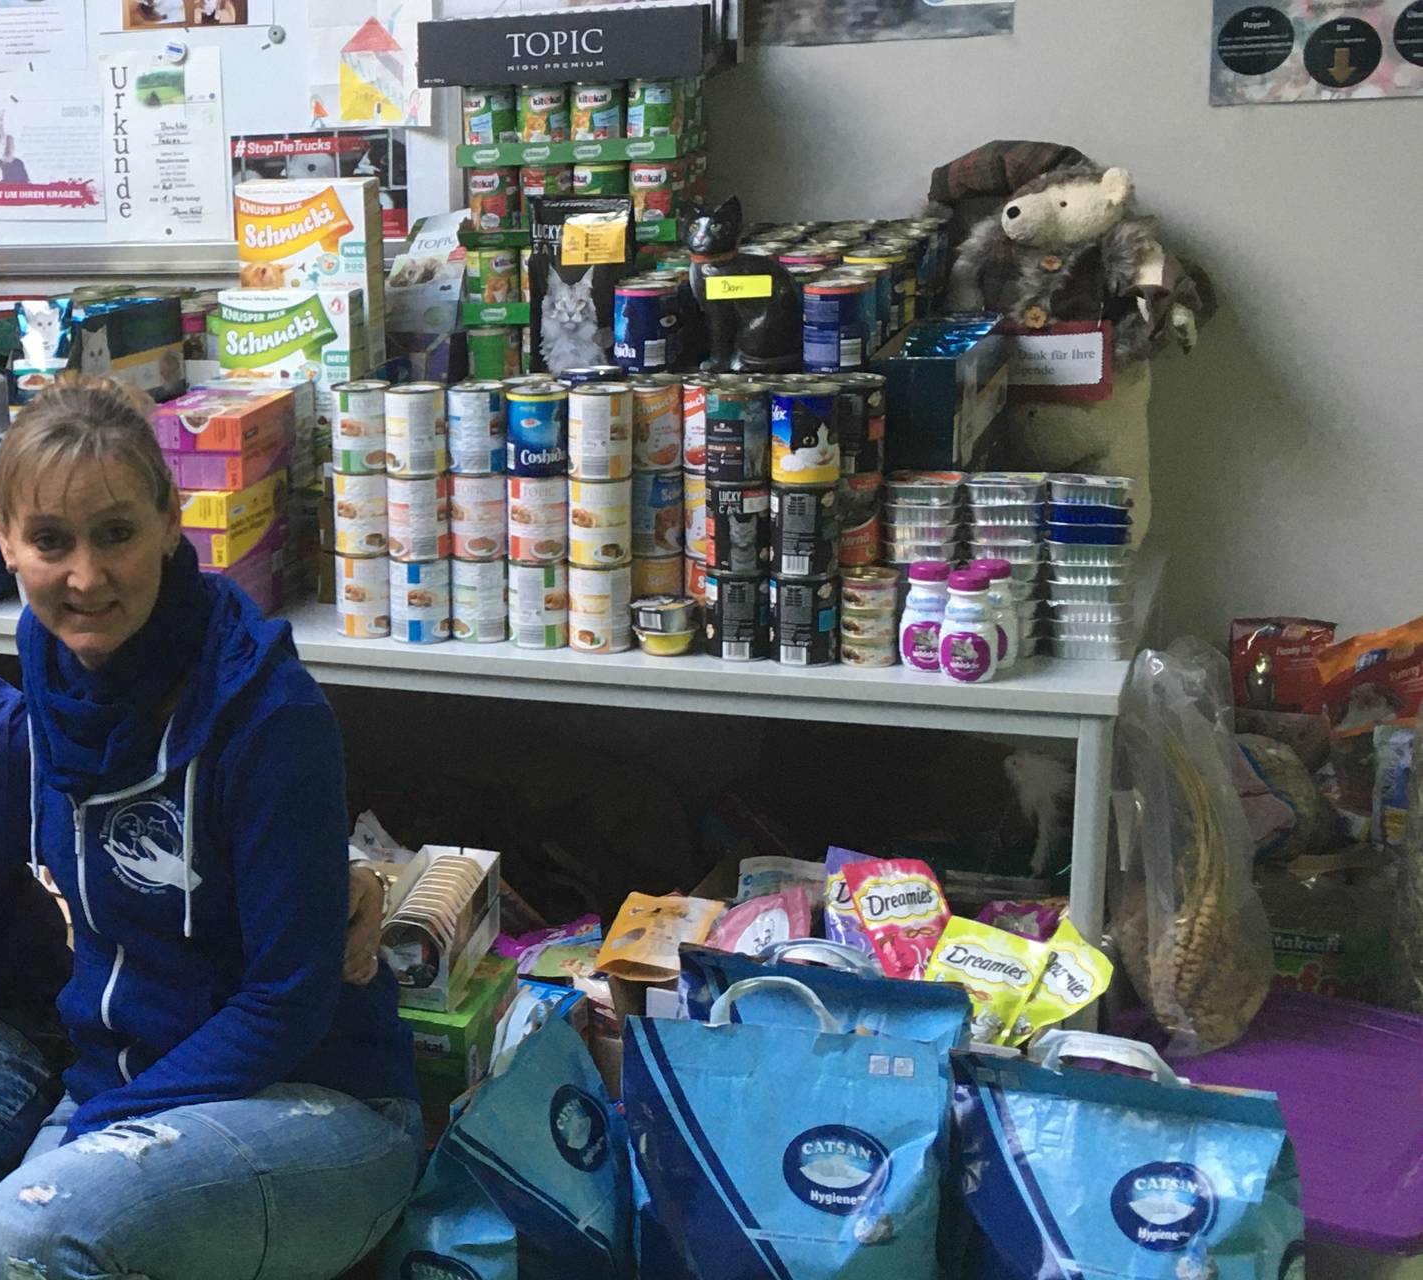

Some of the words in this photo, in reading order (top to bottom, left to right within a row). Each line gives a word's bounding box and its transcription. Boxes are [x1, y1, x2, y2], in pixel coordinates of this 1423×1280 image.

[1243, 20, 1270, 29] Paypal
[506, 28, 603, 58] TOPIC
[507, 64, 538, 72] HIGH
[544, 60, 604, 69] PREMIUM
[578, 93, 608, 104] kitekat
[110, 66, 132, 219] Urkunde
[234, 138, 331, 158] #StopTheTrucks
[633, 174, 662, 184] kitekat
[4, 190, 18, 199] UM
[19, 190, 44, 199] IHREN
[239, 199, 282, 215] KNUSPER
[244, 203, 335, 249] Schnucki
[532, 224, 561, 241] LUCKY
[343, 245, 365, 254] NEU
[221, 306, 266, 322] KNUSPER
[267, 310, 286, 321] MIX
[226, 310, 319, 356] Schnucki
[327, 354, 348, 363] NEU
[1018, 349, 1046, 361] Dank
[1051, 349, 1068, 361] für
[1071, 348, 1095, 360] Ihre
[718, 490, 742, 502] LUCKY
[1389, 665, 1420, 682] Yummy
[865, 886, 934, 917] Dreamies
[1274, 933, 1340, 951] takraft
[946, 945, 1027, 981] Dreamies
[801, 1141, 872, 1161] CATSAN
[810, 1189, 858, 1205] Hygiene
[1138, 1226, 1179, 1242] Hygiene
